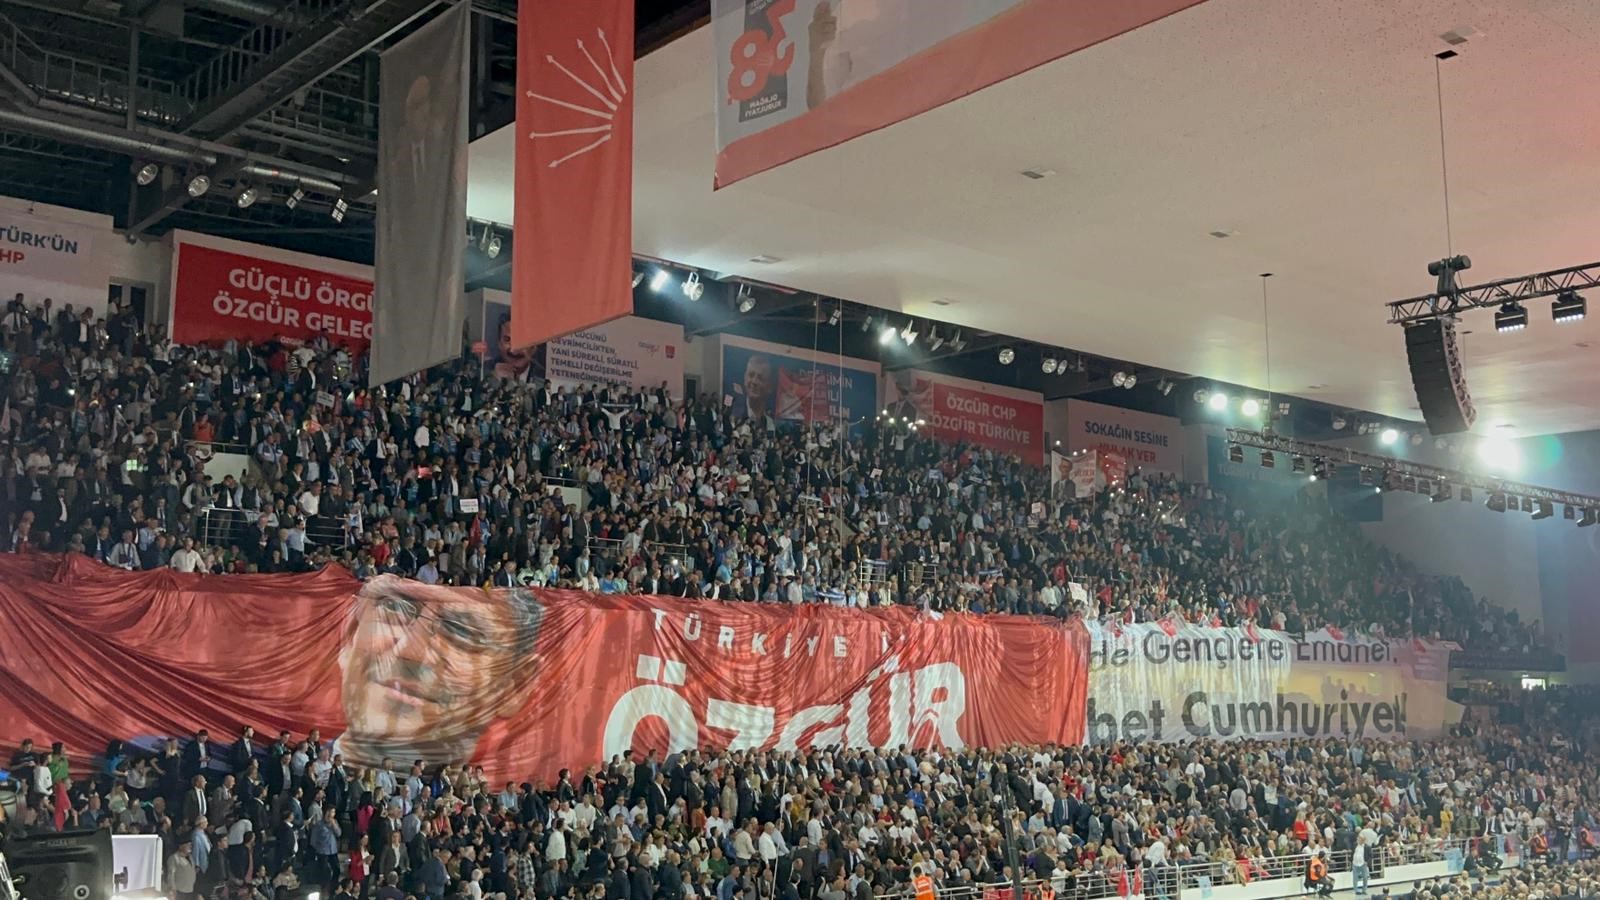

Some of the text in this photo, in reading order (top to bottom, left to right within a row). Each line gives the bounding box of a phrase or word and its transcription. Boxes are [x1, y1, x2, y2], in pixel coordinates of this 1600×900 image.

[229, 266, 311, 300] GÜÇLÜ
[213, 290, 299, 327] ÖZGÜR
[551, 357, 582, 369] TEMELLİ
[946, 392, 1016, 421] ÖZGÜR CHP
[932, 411, 1030, 444] ÖZGÜR TÜRKİYE
[1084, 420, 1169, 447] SOKAĞIN SESİNE
[650, 607, 848, 659] TÜRKİYE
[1143, 629, 1285, 669] Gençlere
[602, 653, 966, 762] ÖZGÜR
